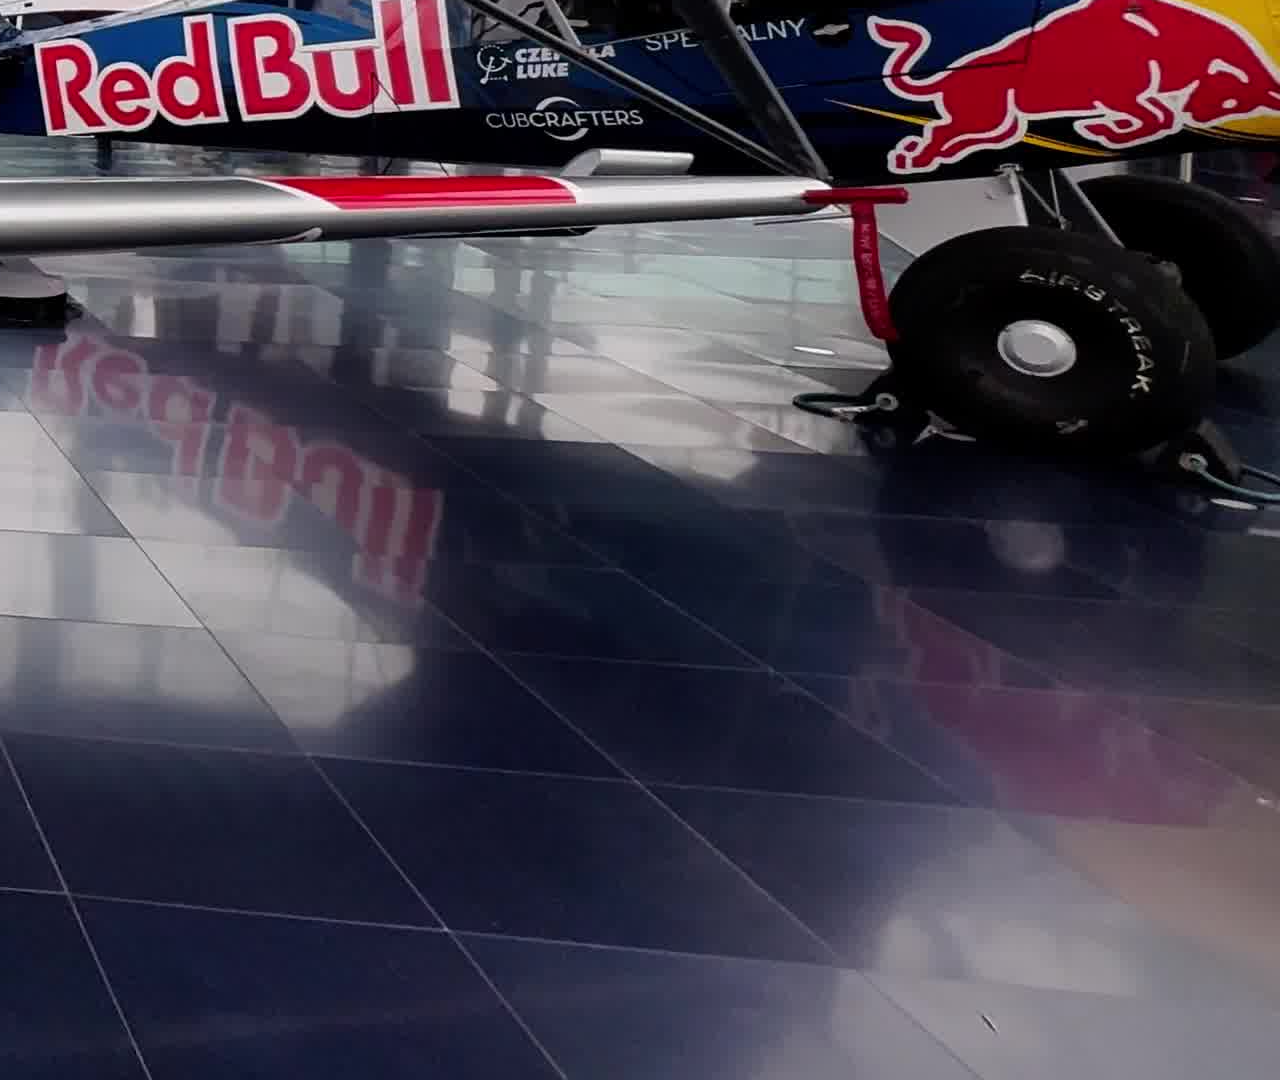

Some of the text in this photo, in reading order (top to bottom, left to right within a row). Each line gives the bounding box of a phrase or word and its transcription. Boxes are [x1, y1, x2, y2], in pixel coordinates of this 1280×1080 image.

[644, 16, 807, 53] SPEALNY
[37, 18, 225, 133] Red
[515, 62, 569, 80] LUKE
[485, 108, 644, 129] CUBCRAFTERS
